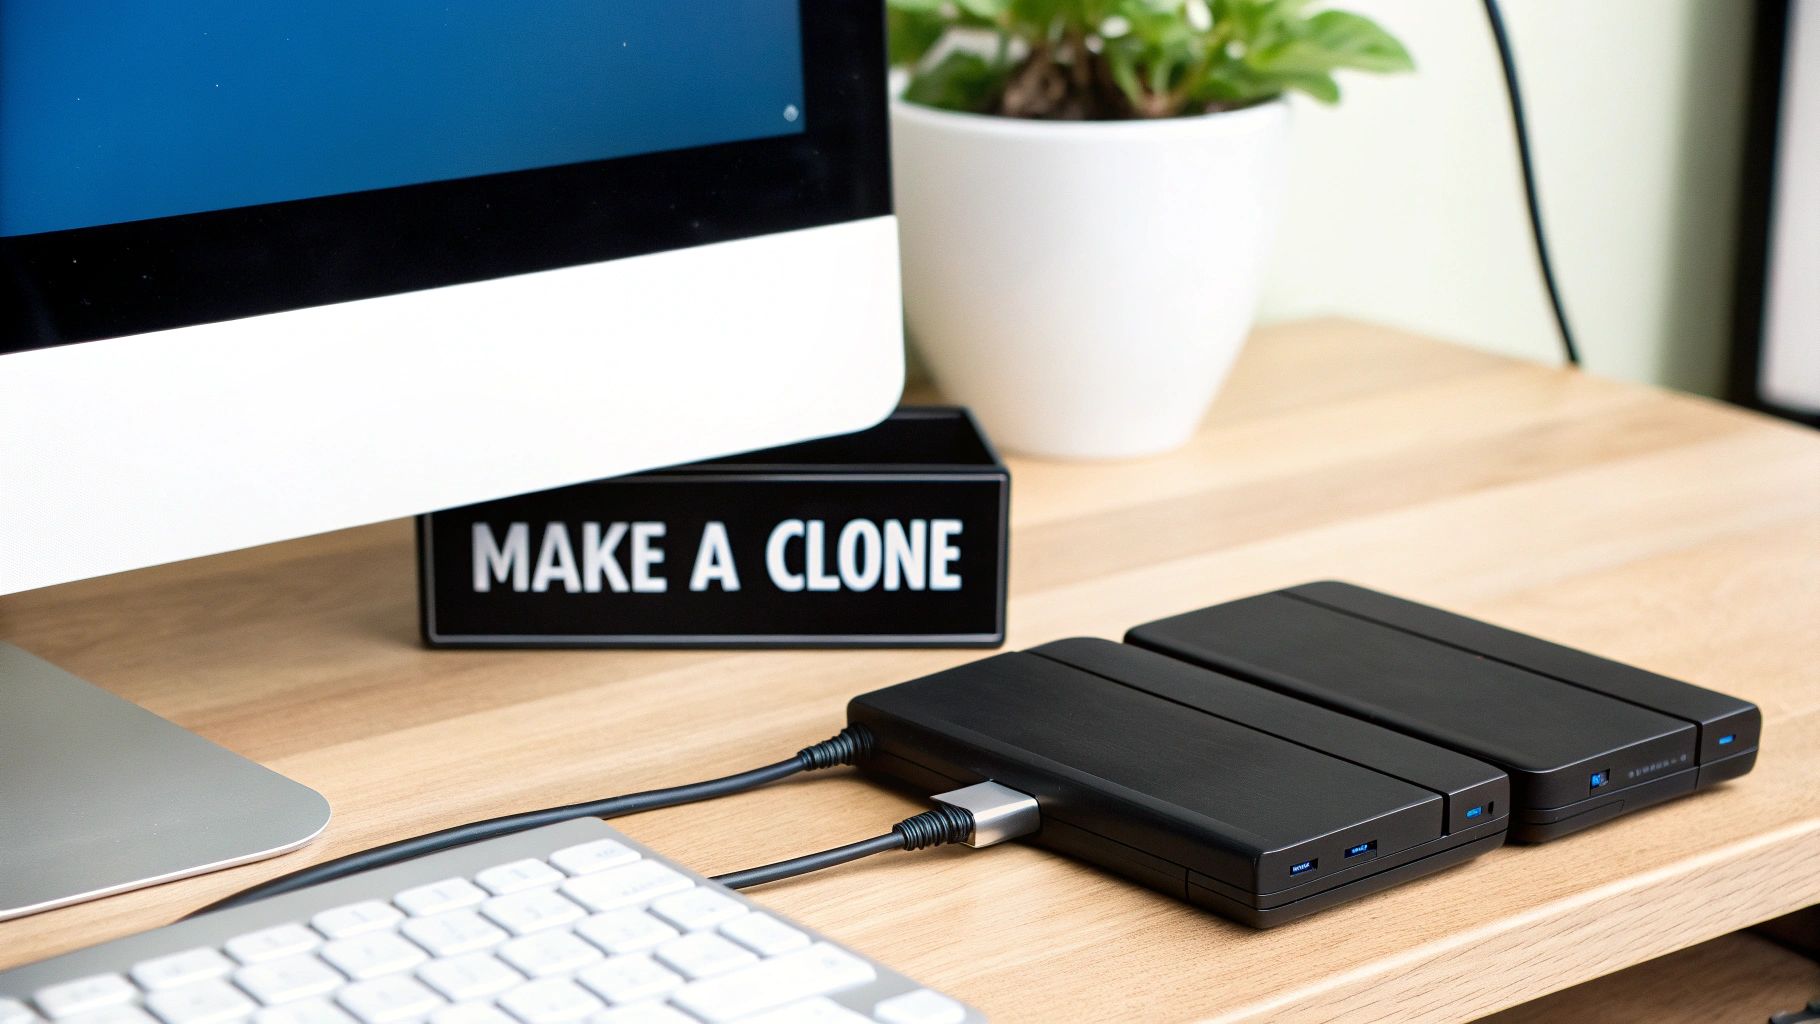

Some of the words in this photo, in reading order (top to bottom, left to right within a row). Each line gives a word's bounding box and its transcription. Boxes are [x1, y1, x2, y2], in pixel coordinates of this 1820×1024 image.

[473, 522, 667, 593] MAKE
[689, 521, 740, 592] A
[766, 518, 963, 592] CLONE
